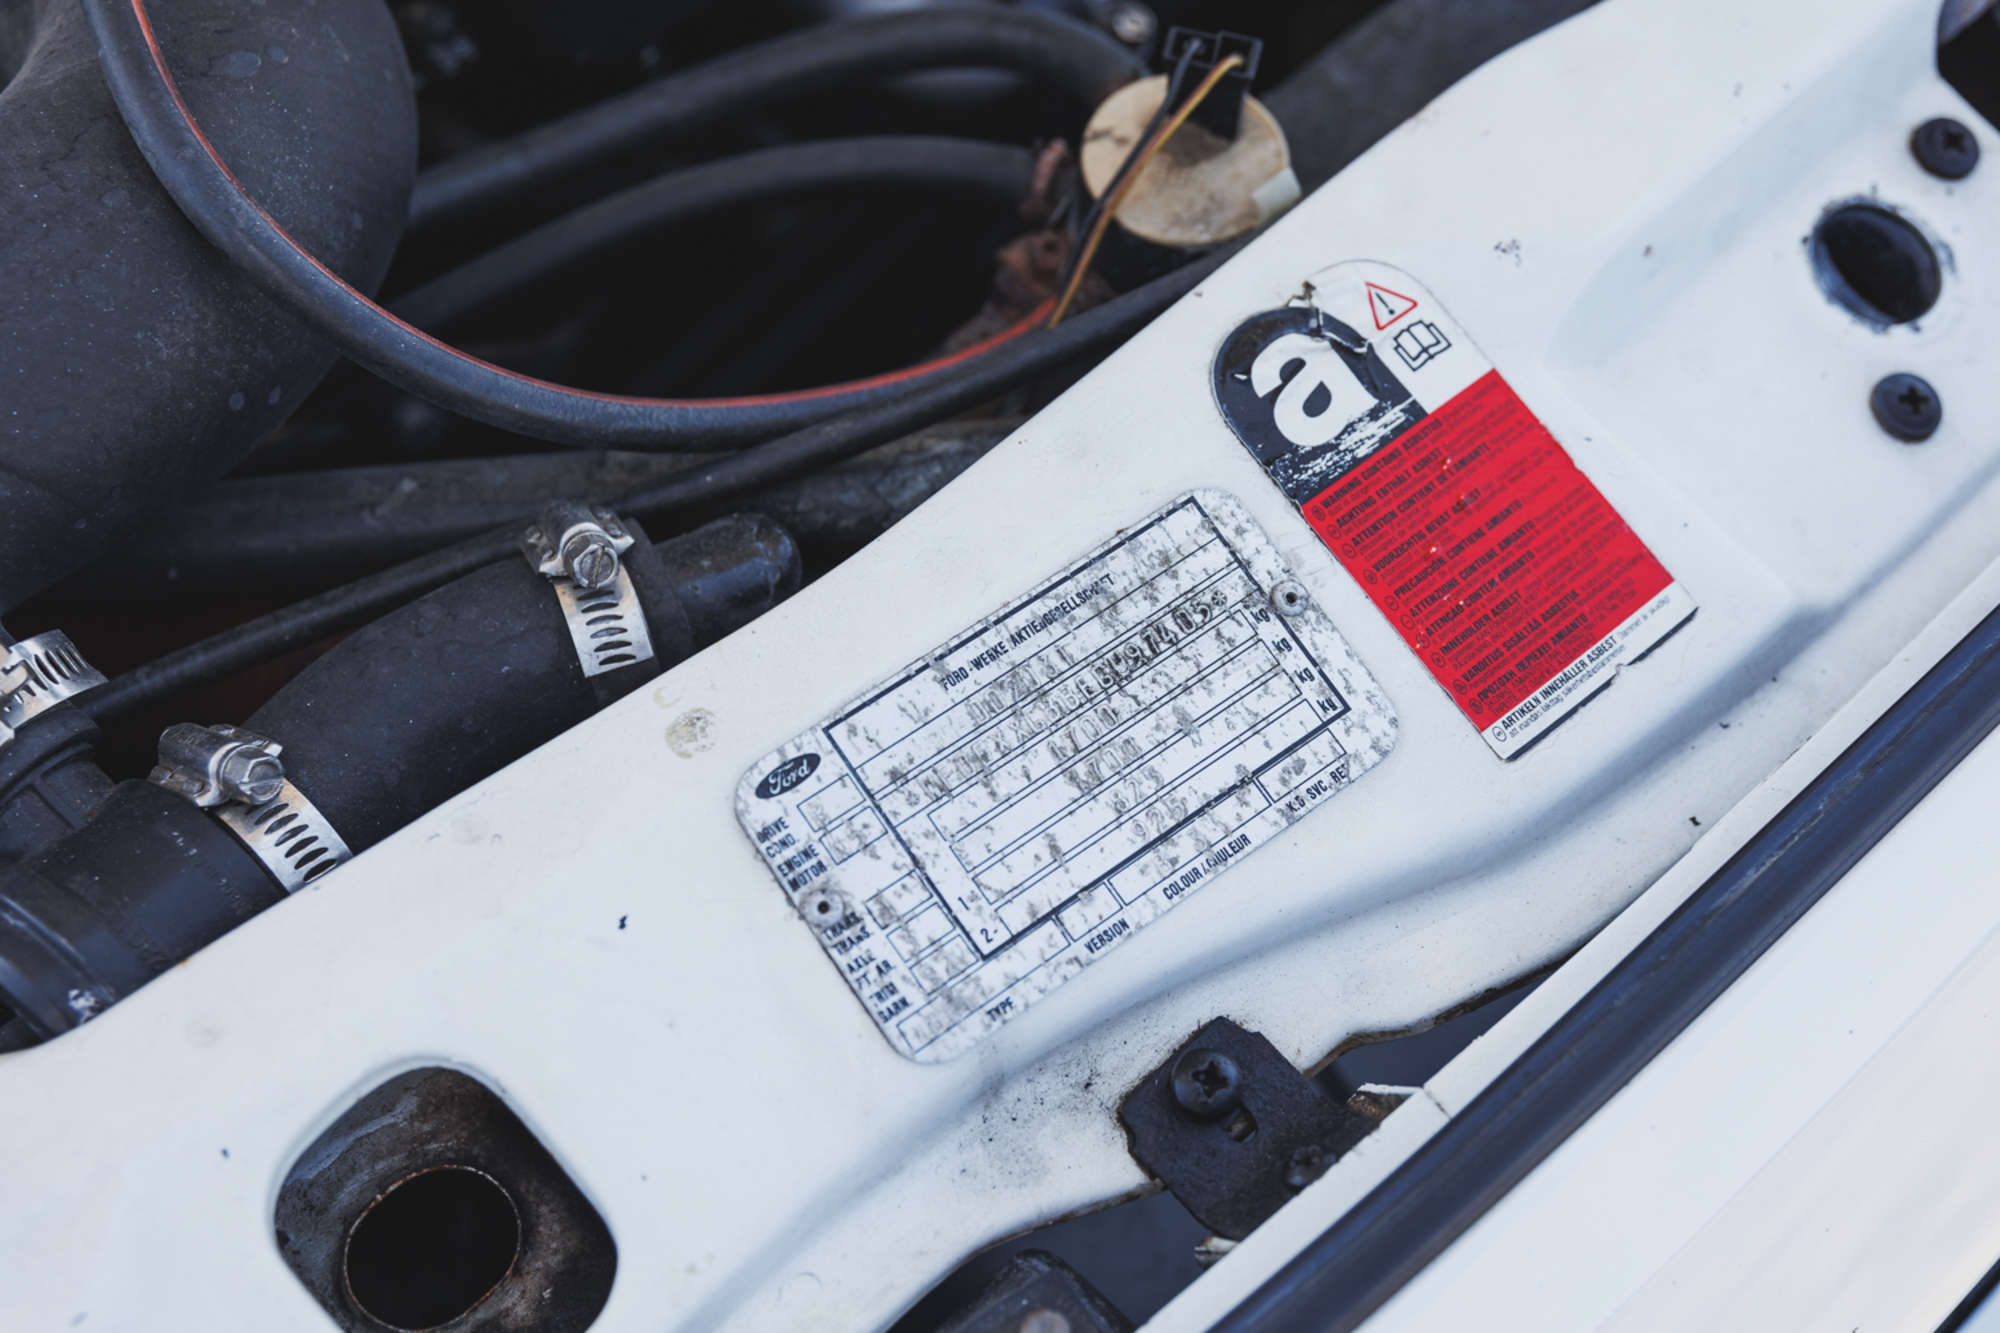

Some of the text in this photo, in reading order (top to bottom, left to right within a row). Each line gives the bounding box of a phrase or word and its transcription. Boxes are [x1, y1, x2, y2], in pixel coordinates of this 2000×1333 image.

[1319, 475, 1362, 510] WARNING
[1359, 446, 1403, 481] CONTAINS
[1400, 417, 1443, 451] ASBESTOS
[1333, 493, 1377, 528] ACHTUNG
[1374, 468, 1412, 499] ENTHÄLT
[1409, 446, 1443, 473] ASBEST
[1349, 508, 1398, 547] ATTENTION
[1394, 479, 1438, 514] CONTIENT
[1434, 471, 1448, 485] DE
[1370, 528, 1427, 573] VOORZICHTIG
[1423, 509, 1452, 534] BEVAT
[1444, 526, 1486, 561] CONTIENE
[1482, 498, 1524, 532] AMIANTO
[1407, 575, 1460, 618] ATTENZIONE
[1457, 546, 1499, 580] CONTIENE
[1495, 518, 1536, 552] AMIANTO
[1495, 548, 1536, 582] AMIANTO
[1248, 603, 1272, 627] kg
[1438, 588, 1523, 656] INNEHOLDER ASBEST
[1271, 634, 1293, 656] kg
[1460, 645, 1505, 683] VAROITUS
[1537, 587, 1580, 623] ASBESTIA
[1293, 663, 1316, 686] kg
[1499, 694, 1542, 731] ARTIKELN
[1537, 657, 1589, 701] INNEHÅLLER
[1584, 634, 1618, 664] ASBEST
[754, 815, 790, 845] DRIVE
[775, 842, 820, 877] ENGINE
[786, 859, 828, 892] MOTOR
[1083, 916, 1131, 955] VERSION
[844, 948, 876, 975] AXLE
[985, 996, 1016, 1022] TYPE
